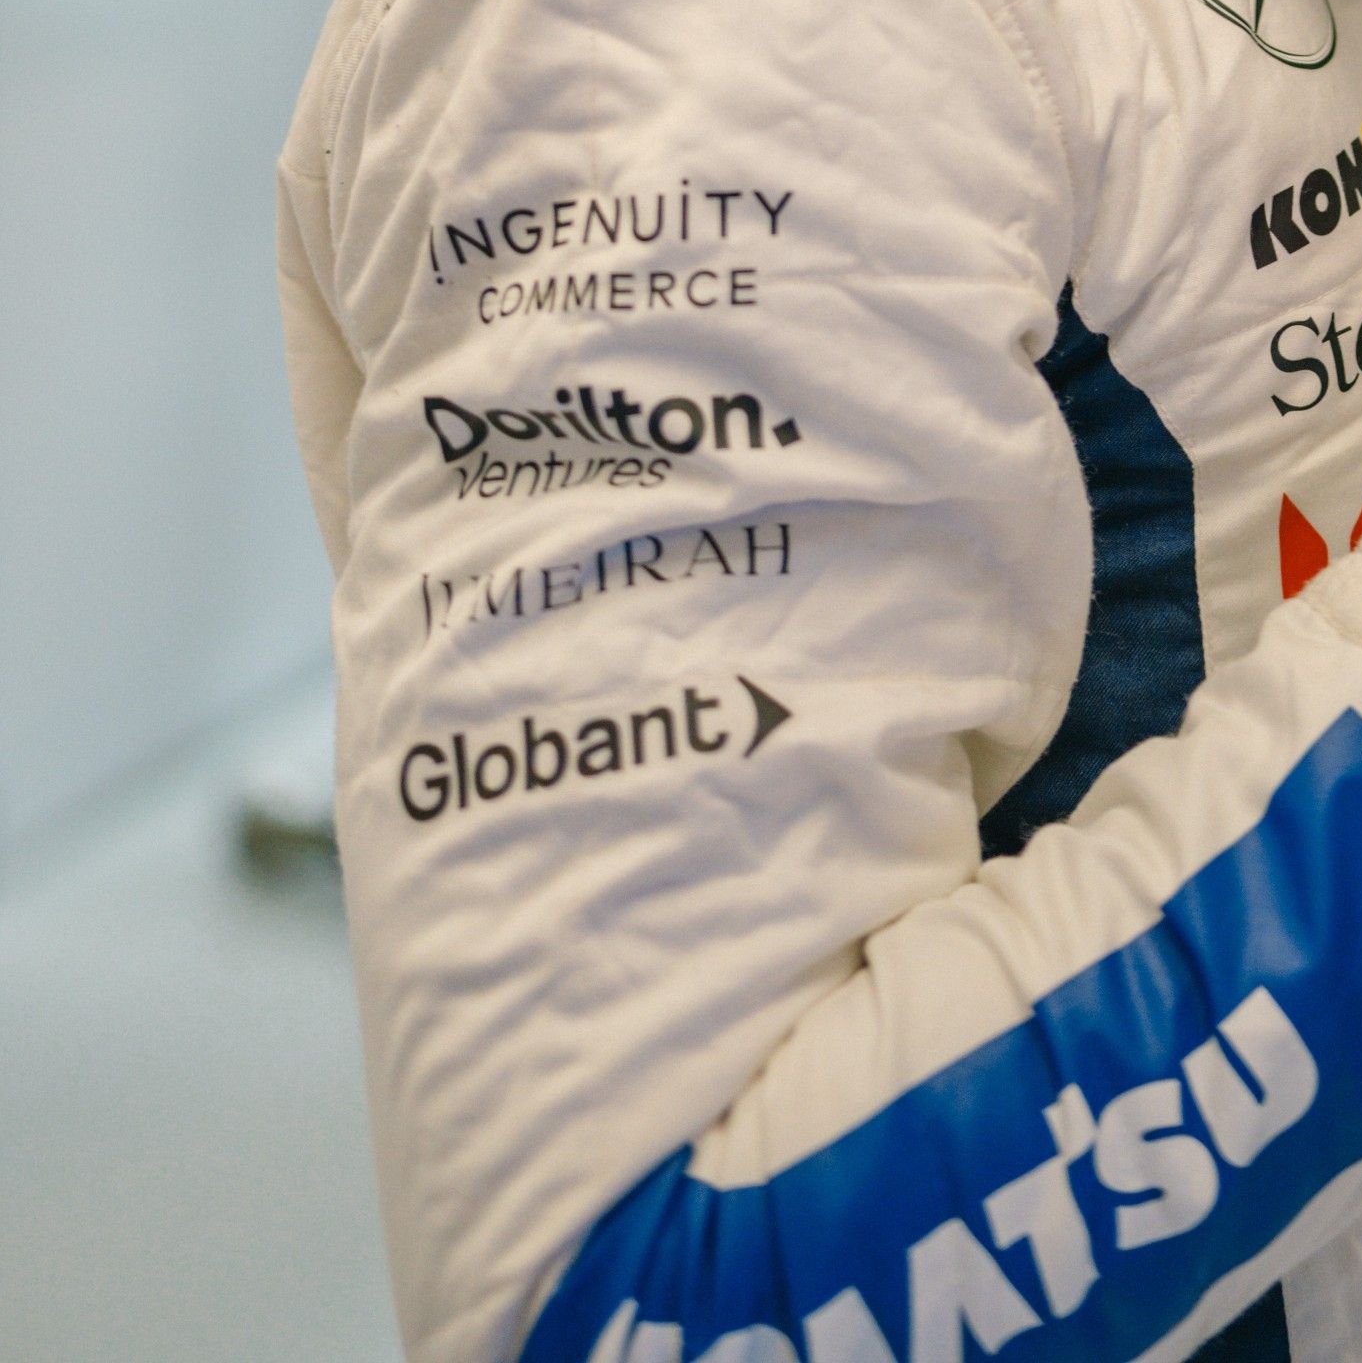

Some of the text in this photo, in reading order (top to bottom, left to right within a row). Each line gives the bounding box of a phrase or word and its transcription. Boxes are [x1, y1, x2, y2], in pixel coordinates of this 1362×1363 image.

[478, 268, 759, 325] COMMERCE
[456, 450, 673, 500] Ventures
[399, 686, 732, 823] Globant
